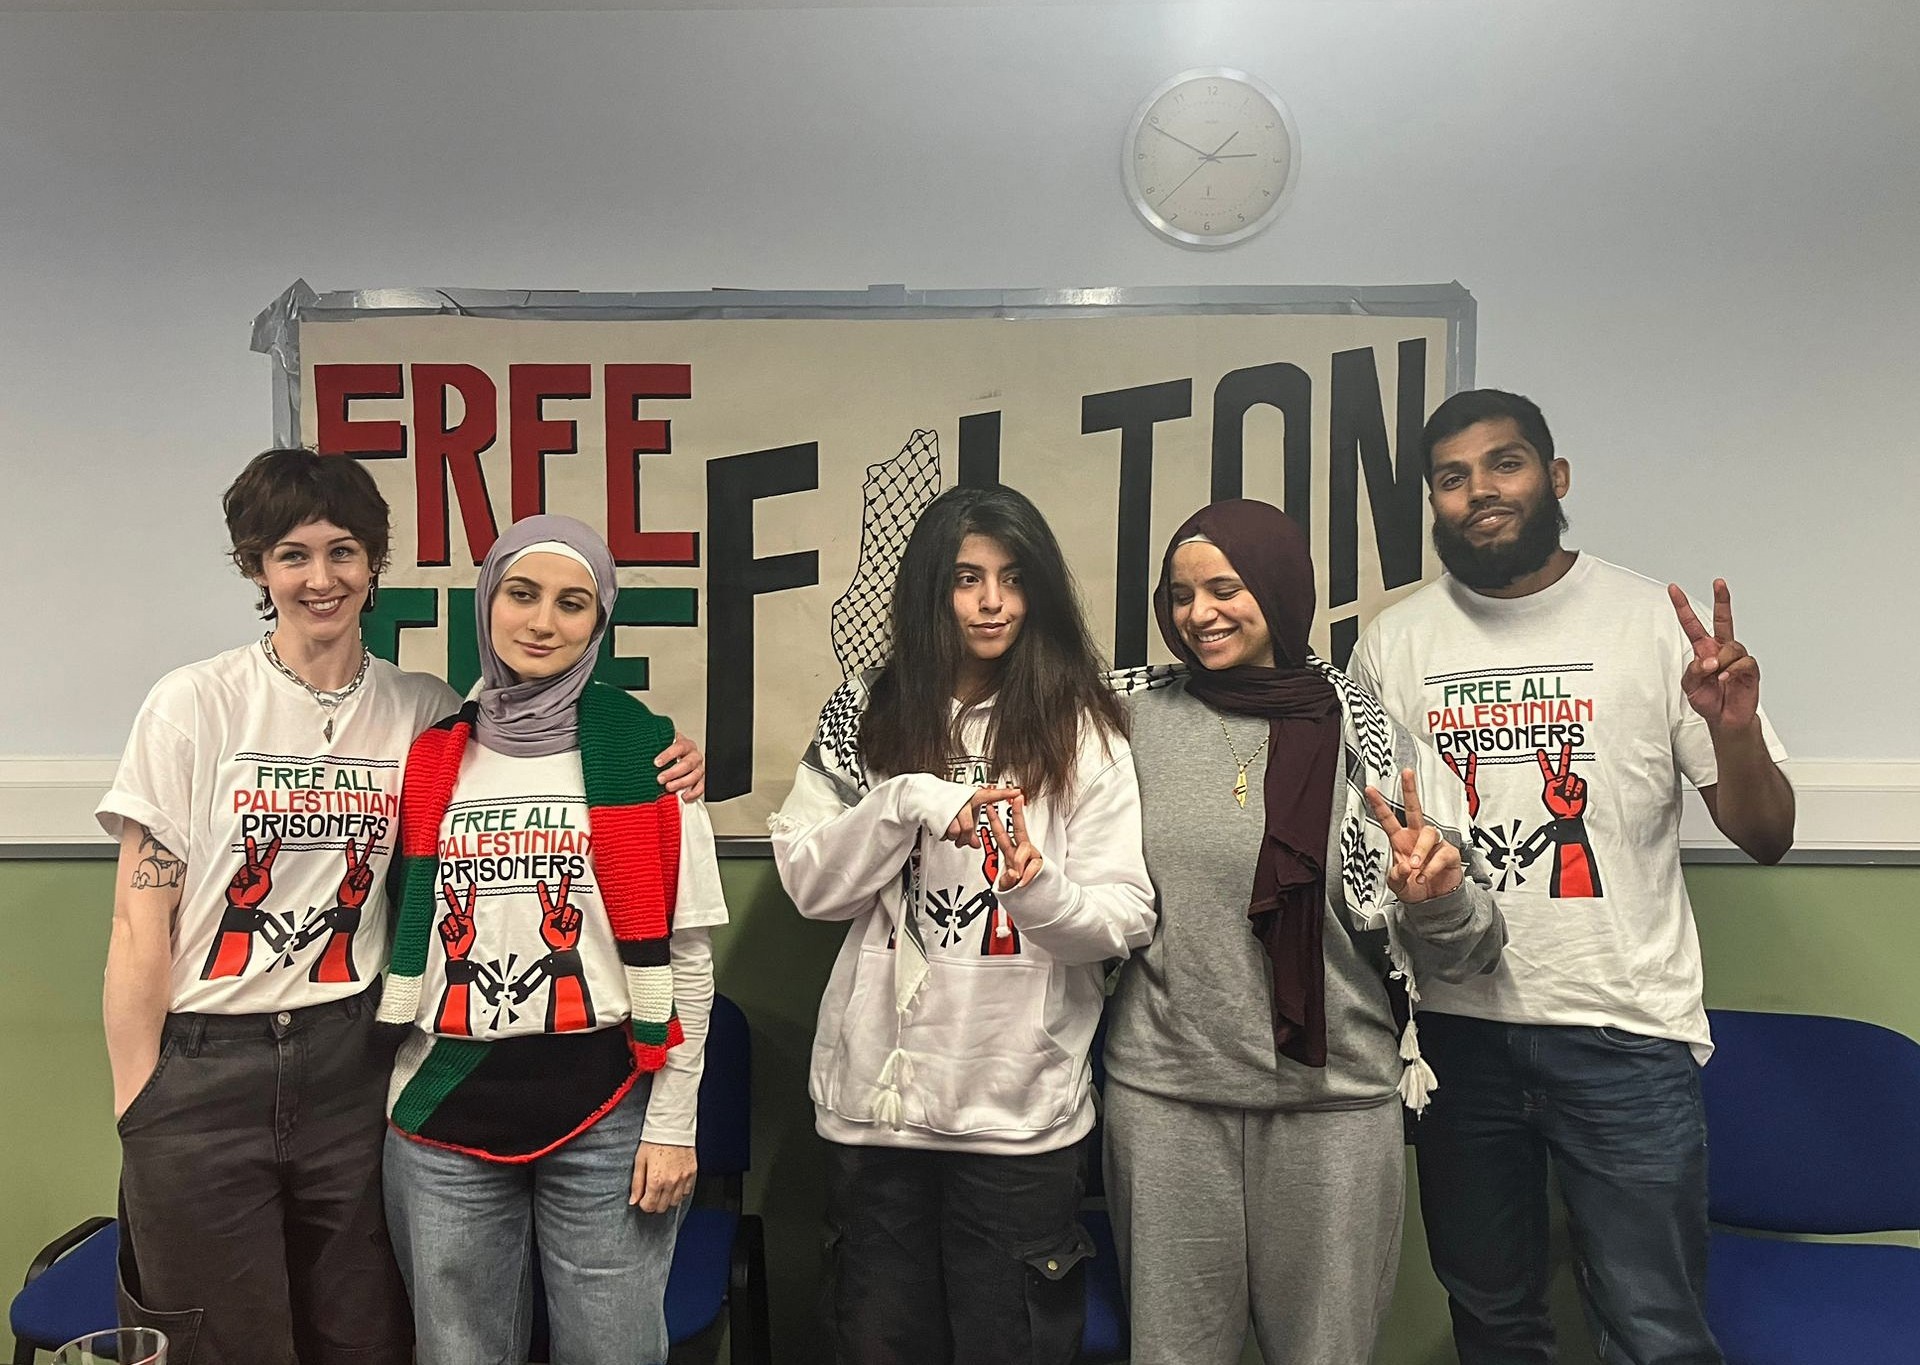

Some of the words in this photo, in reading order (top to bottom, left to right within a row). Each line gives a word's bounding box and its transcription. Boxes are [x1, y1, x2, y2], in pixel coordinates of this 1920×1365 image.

[1208, 86, 1218, 96] 12
[1145, 186, 1155, 195] 8
[1262, 189, 1272, 198] 4
[1169, 213, 1178, 222] 7
[1203, 221, 1211, 231] 6
[1237, 213, 1246, 223] 5
[314, 364, 700, 567] FREE
[1444, 680, 1512, 707] FREE
[1521, 676, 1571, 702] ALL
[1427, 698, 1593, 733] PALESTINIAN
[1435, 723, 1585, 755] PRISONERS
[257, 765, 325, 790] FREE
[334, 769, 383, 792] ALL
[233, 789, 399, 818] PALESTINIAN
[241, 813, 389, 840] PRISONERS
[450, 808, 517, 835] FREE
[524, 807, 576, 830] ALL
[440, 855, 585, 885] PRISONERS
